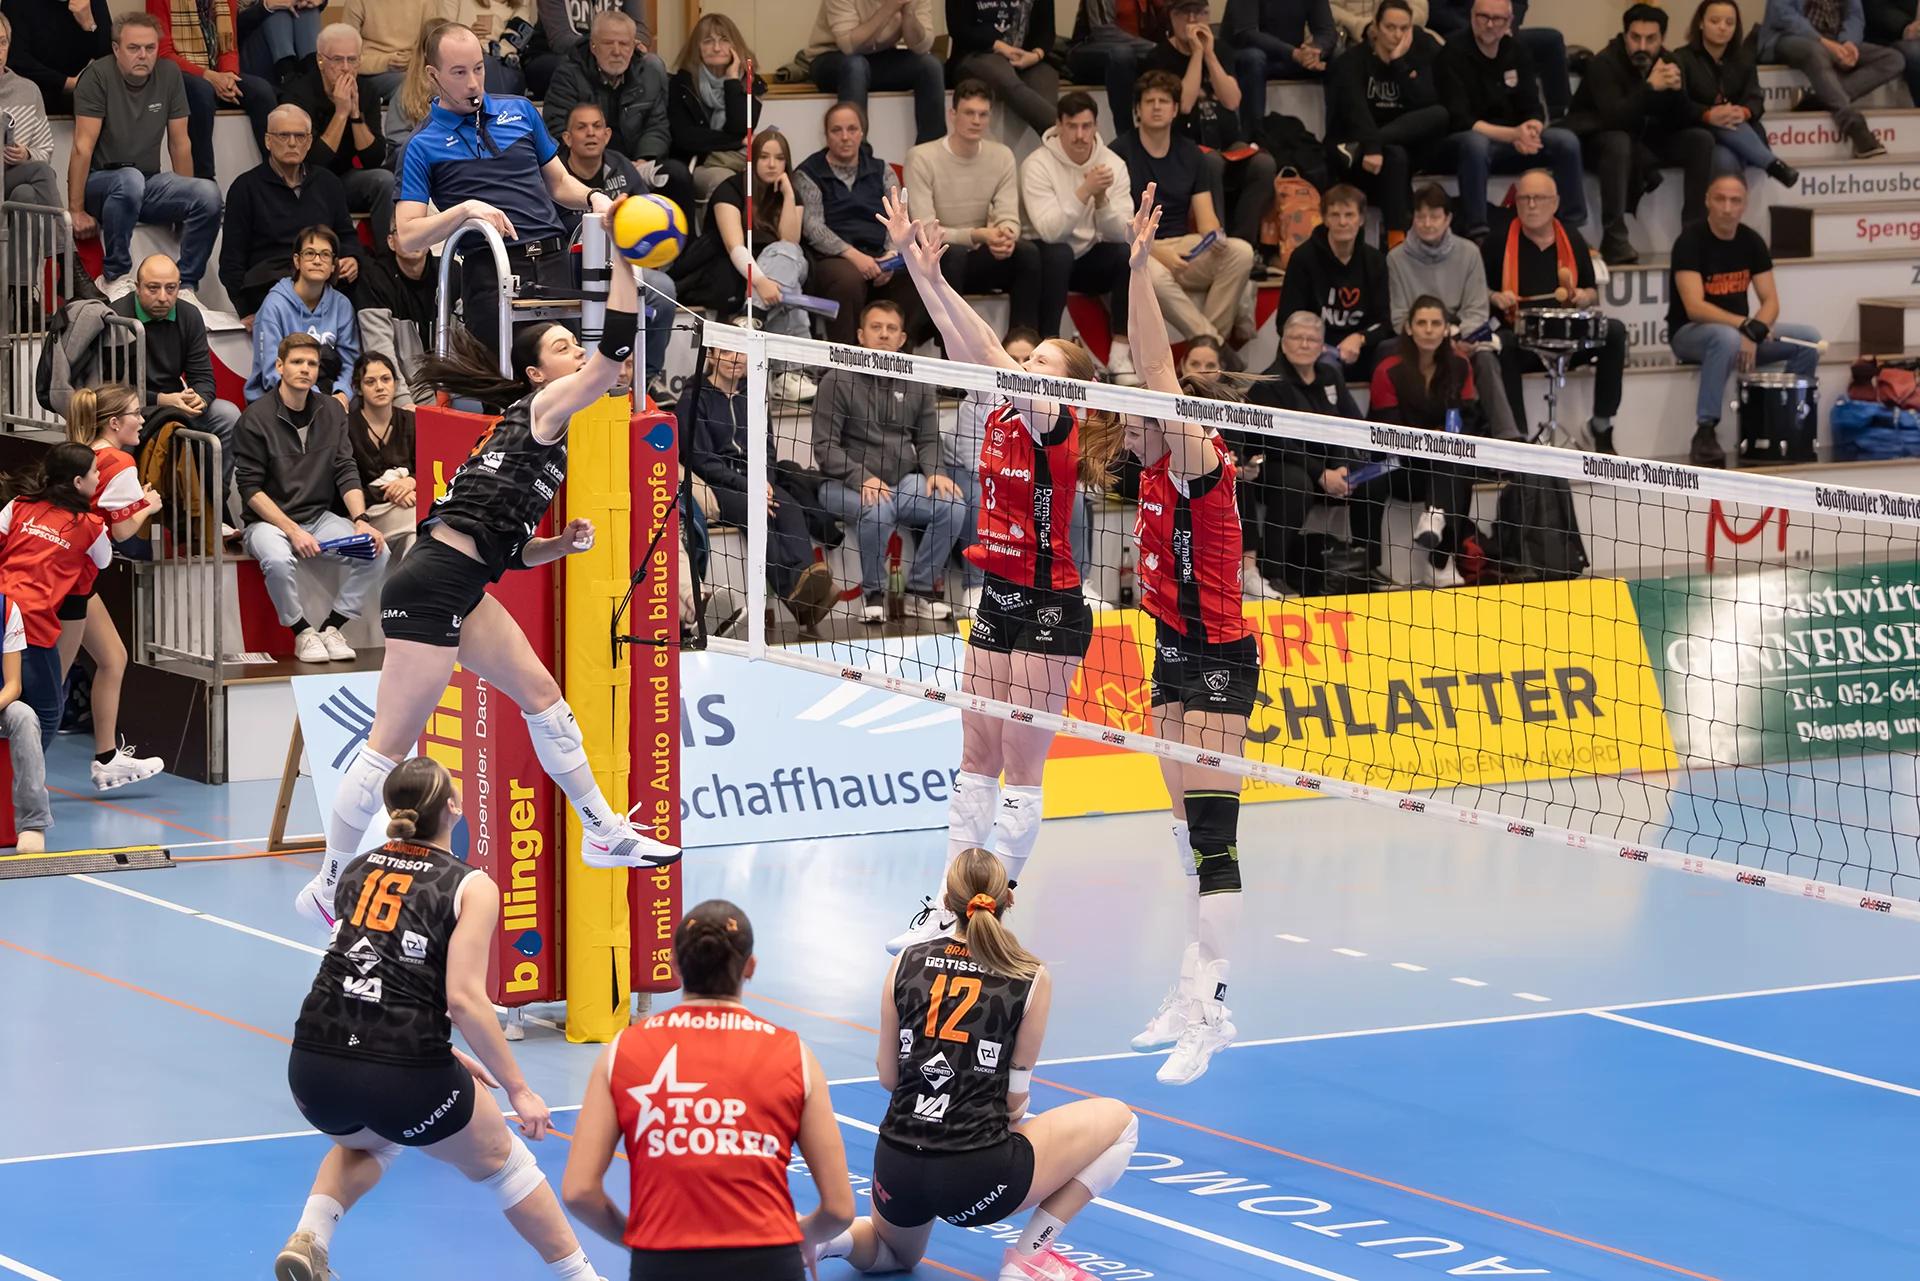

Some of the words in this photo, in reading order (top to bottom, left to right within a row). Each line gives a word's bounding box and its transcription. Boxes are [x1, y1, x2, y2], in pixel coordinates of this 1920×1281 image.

[1767, 124, 1896, 146] edachuen
[1321, 305, 1364, 327] NUC
[647, 461, 671, 545] Tropfe
[985, 477, 996, 510] 3
[649, 550, 668, 620] blaue
[649, 676, 669, 722] und
[1786, 688, 1833, 711] Tel.
[1838, 678, 1920, 708] 052-64
[1796, 719, 1891, 743] Dienstag
[651, 731, 670, 791] Auto
[1539, 743, 1621, 767] AKKORD
[651, 801, 671, 842] ote
[386, 856, 434, 873] TISSOT
[350, 868, 414, 933] 16
[652, 898, 672, 940] mit
[653, 950, 672, 982] Dä
[667, 1011, 777, 1036] Mobilière
[924, 973, 983, 1043] 12
[402, 1089, 461, 1139] SUVEMA
[666, 1097, 747, 1126] TOP
[946, 1181, 1008, 1225] SUVEMA
